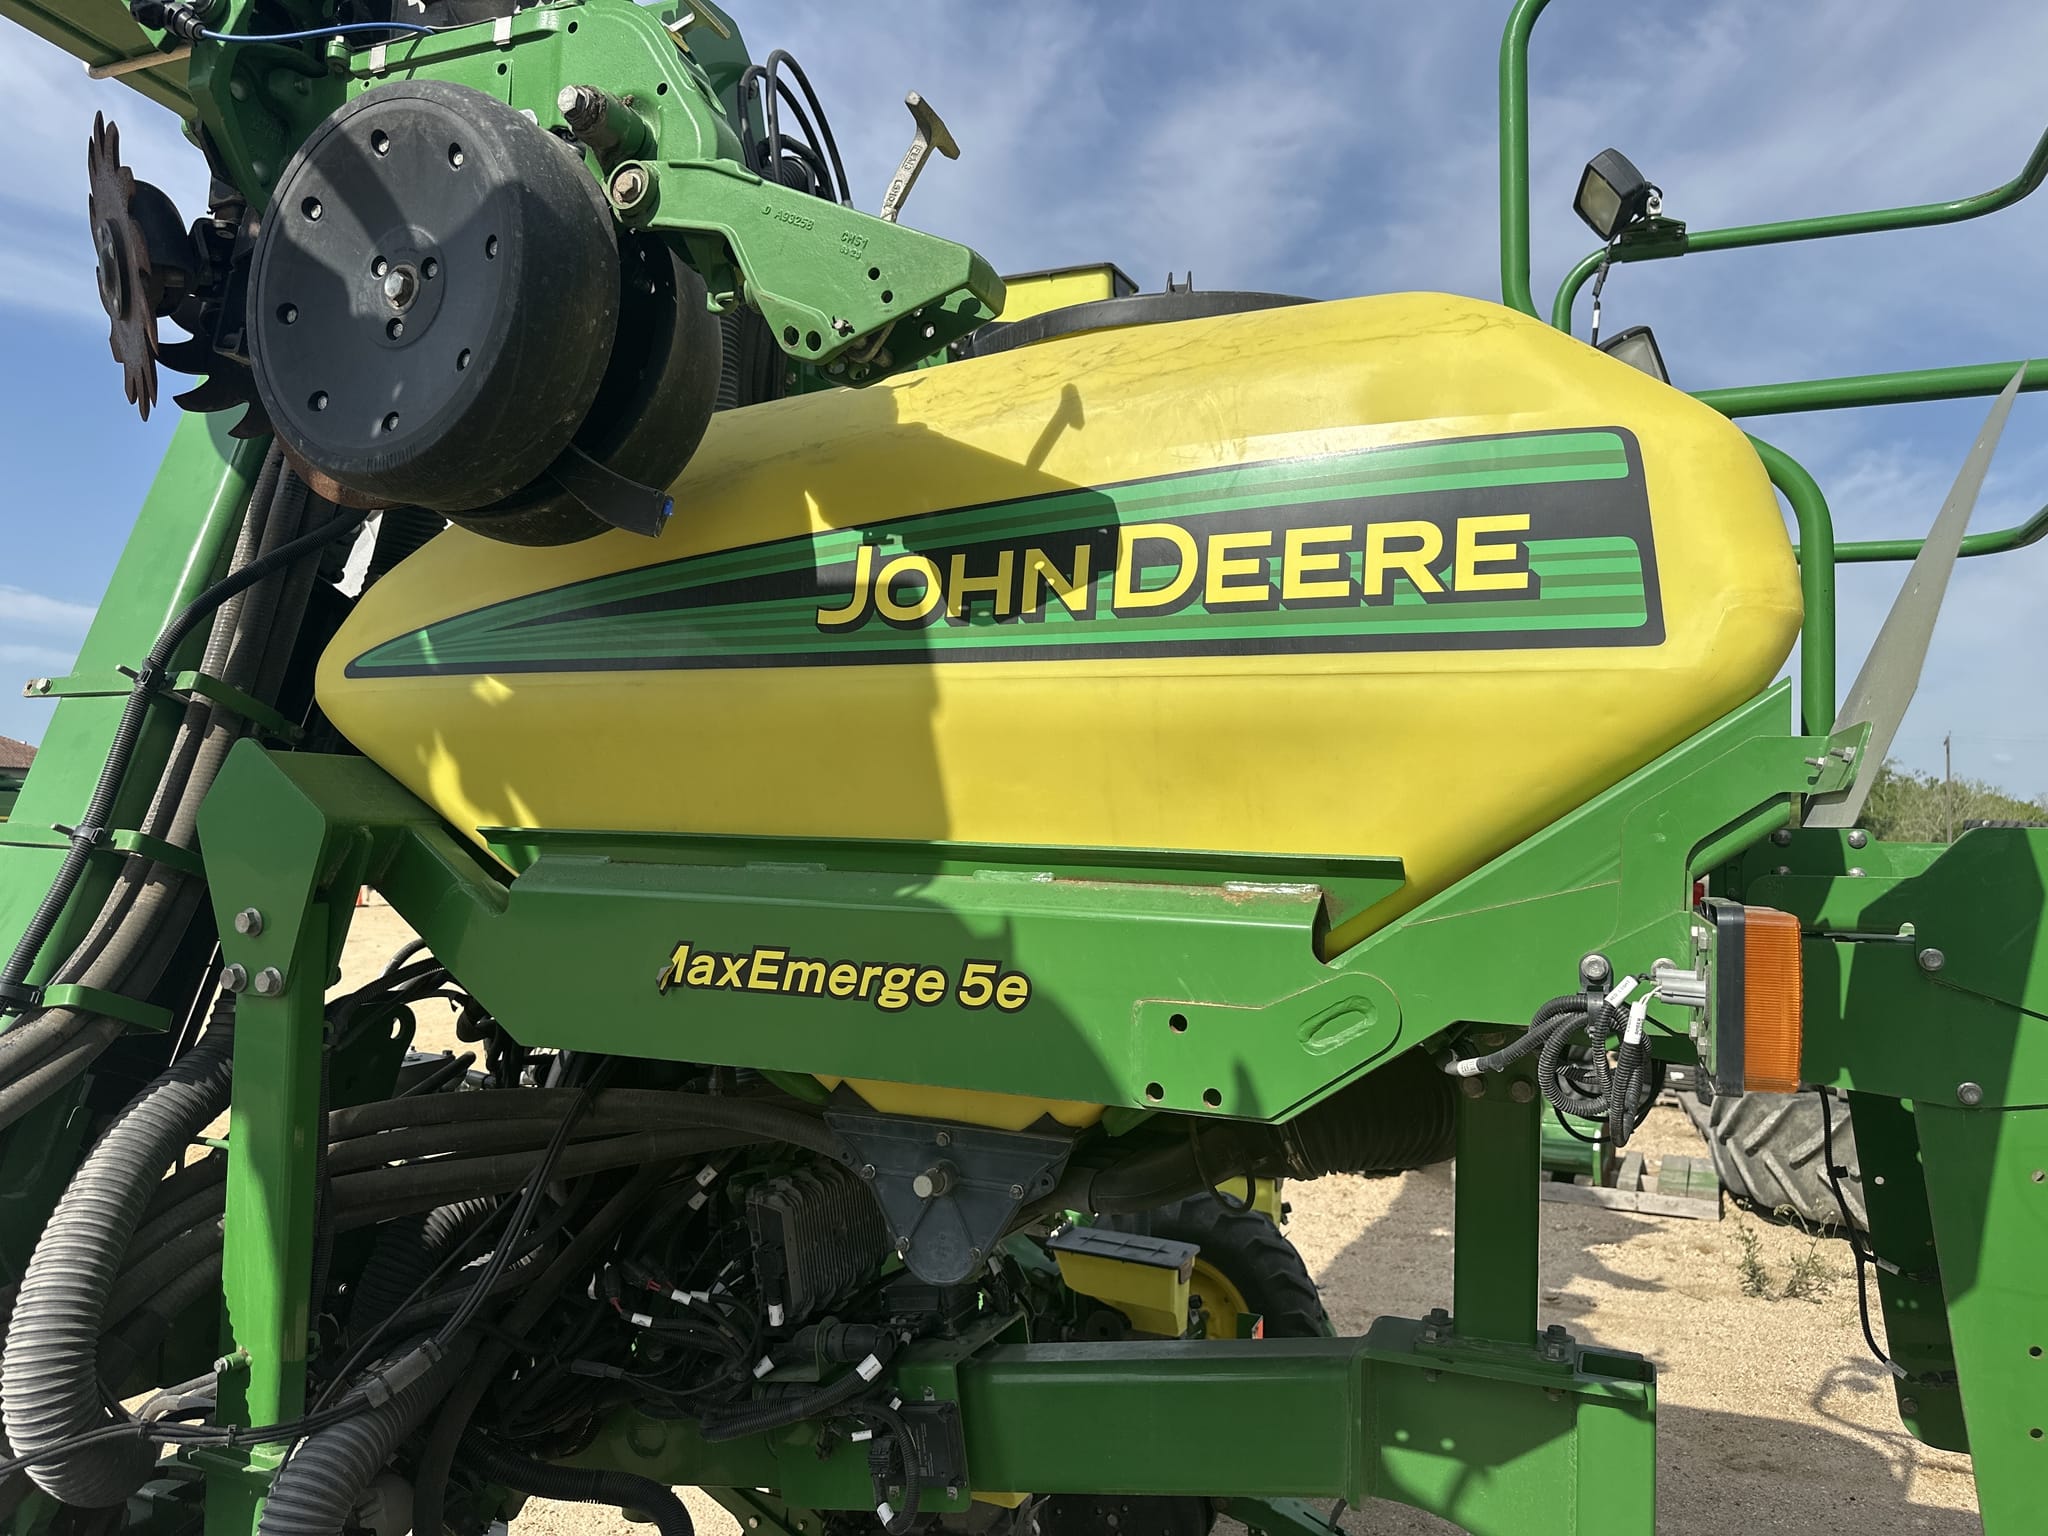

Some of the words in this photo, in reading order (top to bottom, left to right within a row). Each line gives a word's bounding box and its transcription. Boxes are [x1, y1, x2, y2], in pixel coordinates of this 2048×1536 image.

[816, 544, 1092, 626] JOHN
[1113, 513, 1534, 611] DEERE
[958, 962, 1030, 1010] 5e
